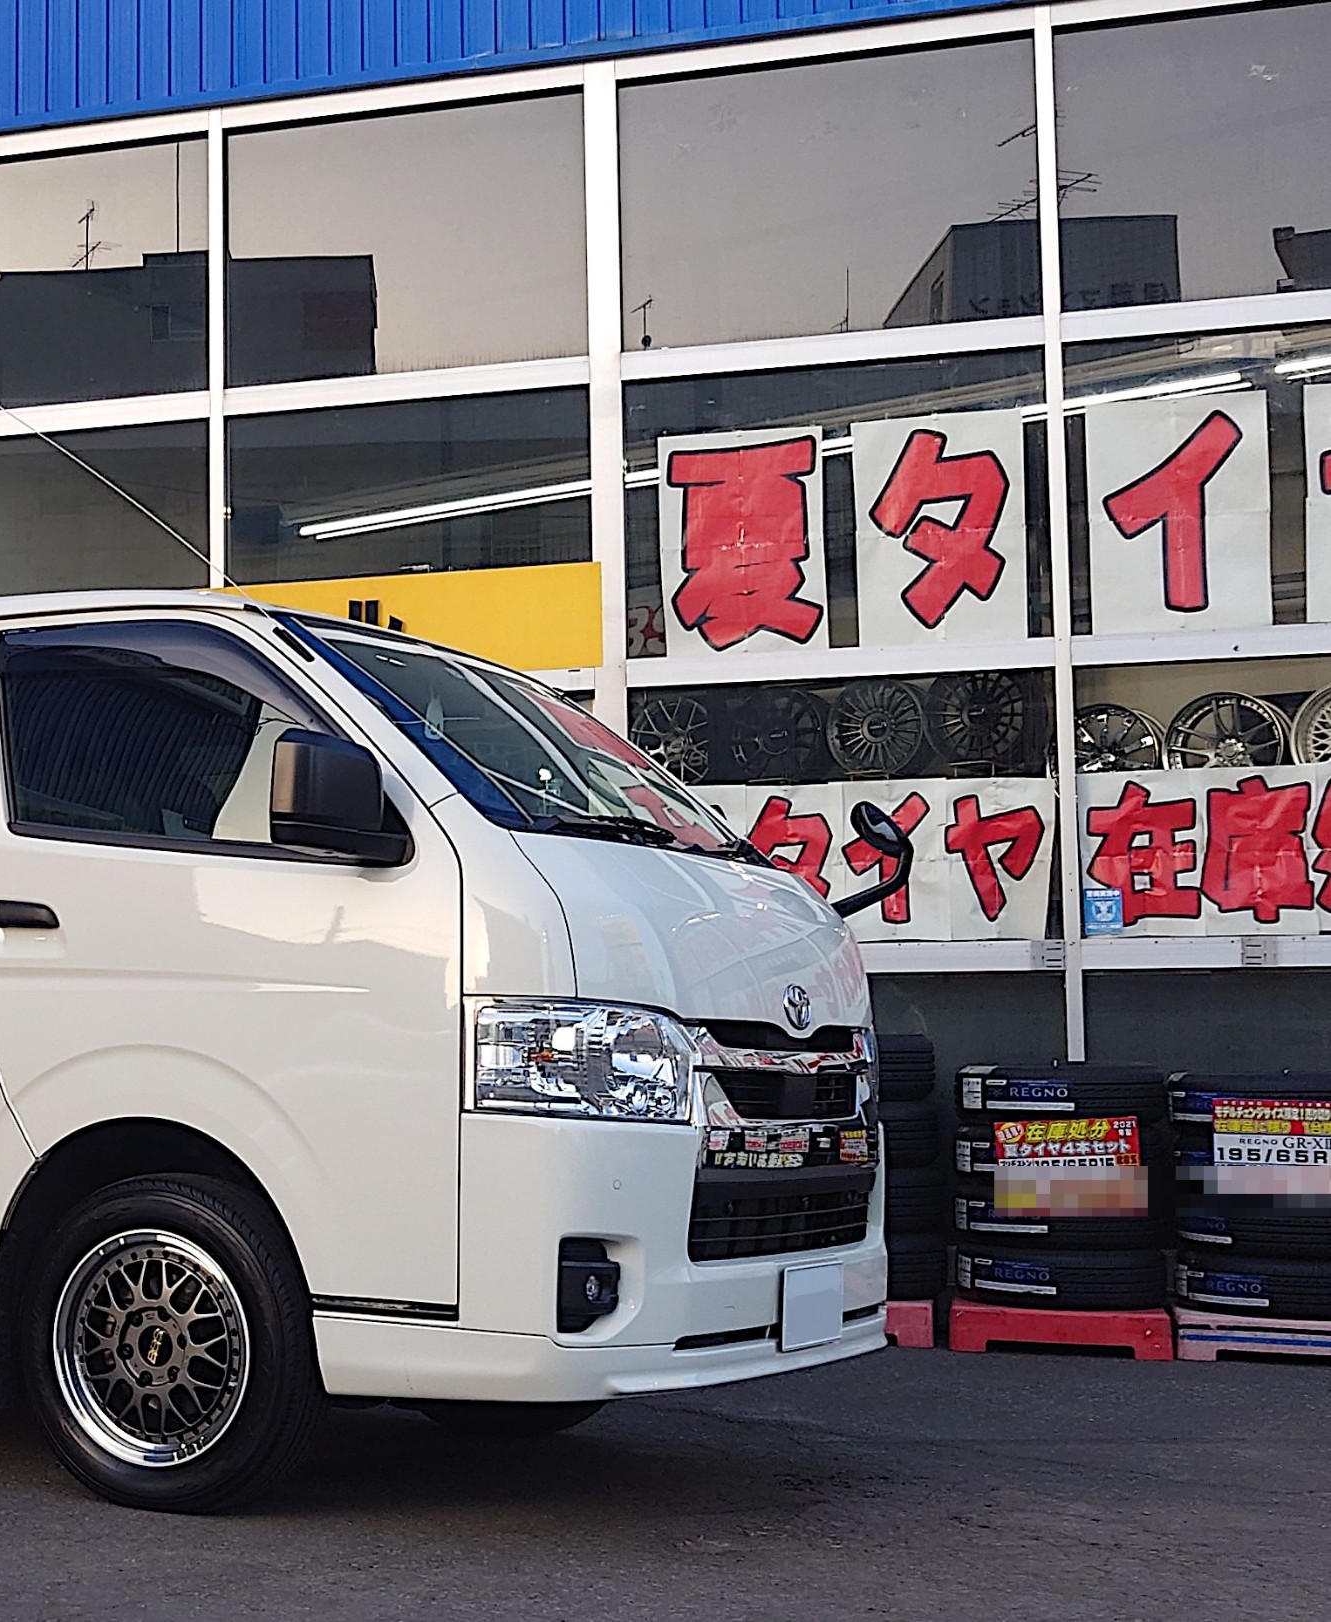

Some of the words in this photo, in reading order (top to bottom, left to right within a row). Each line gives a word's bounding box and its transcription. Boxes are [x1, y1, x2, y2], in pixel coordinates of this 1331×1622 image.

[667, 409, 1331, 652] 夏タイ
[1009, 1087, 1068, 1098] REGNO
[1026, 1119, 1111, 1141] 在庫処分
[1113, 1120, 1137, 1128] 2021
[1217, 1147, 1328, 1164] 195/65R
[994, 1267, 1050, 1281] REGNO
[1206, 1281, 1262, 1294] REGNO
[146, 1327, 168, 1365] BBS
